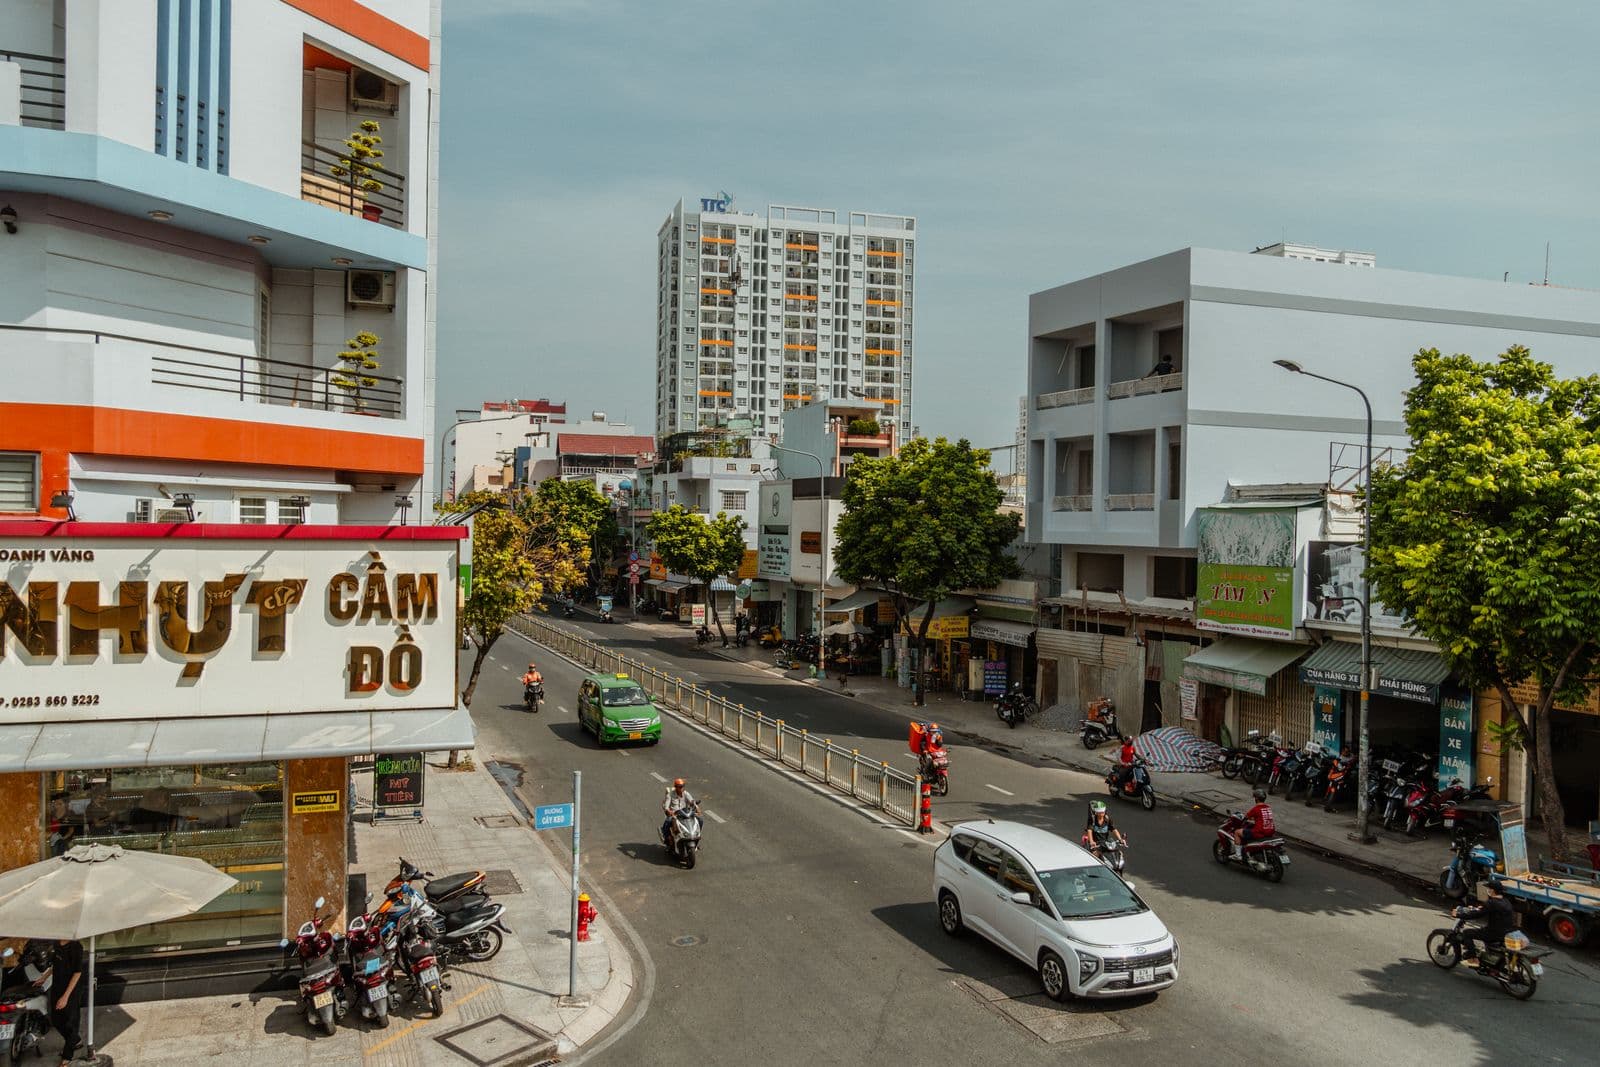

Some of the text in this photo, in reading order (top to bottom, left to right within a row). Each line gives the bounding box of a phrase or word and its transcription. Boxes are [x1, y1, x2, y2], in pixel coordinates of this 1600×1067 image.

[700, 198, 727, 213] TTC
[50, 547, 94, 562] VÀNG
[329, 551, 438, 620] CẦM
[347, 624, 422, 692] ĐỒ
[1307, 668, 1323, 678] CỬA
[1325, 670, 1346, 681] HÀNG
[1349, 673, 1359, 683] XE
[46, 696, 67, 706] 860
[72, 695, 99, 705] 5232
[1319, 695, 1336, 706] BÁN
[1444, 698, 1467, 710] MUA
[1322, 713, 1333, 723] XE
[1444, 716, 1466, 730] BÁN
[1318, 730, 1337, 741] MÁY
[1448, 737, 1462, 749] XE
[1442, 756, 1466, 768] MÁY
